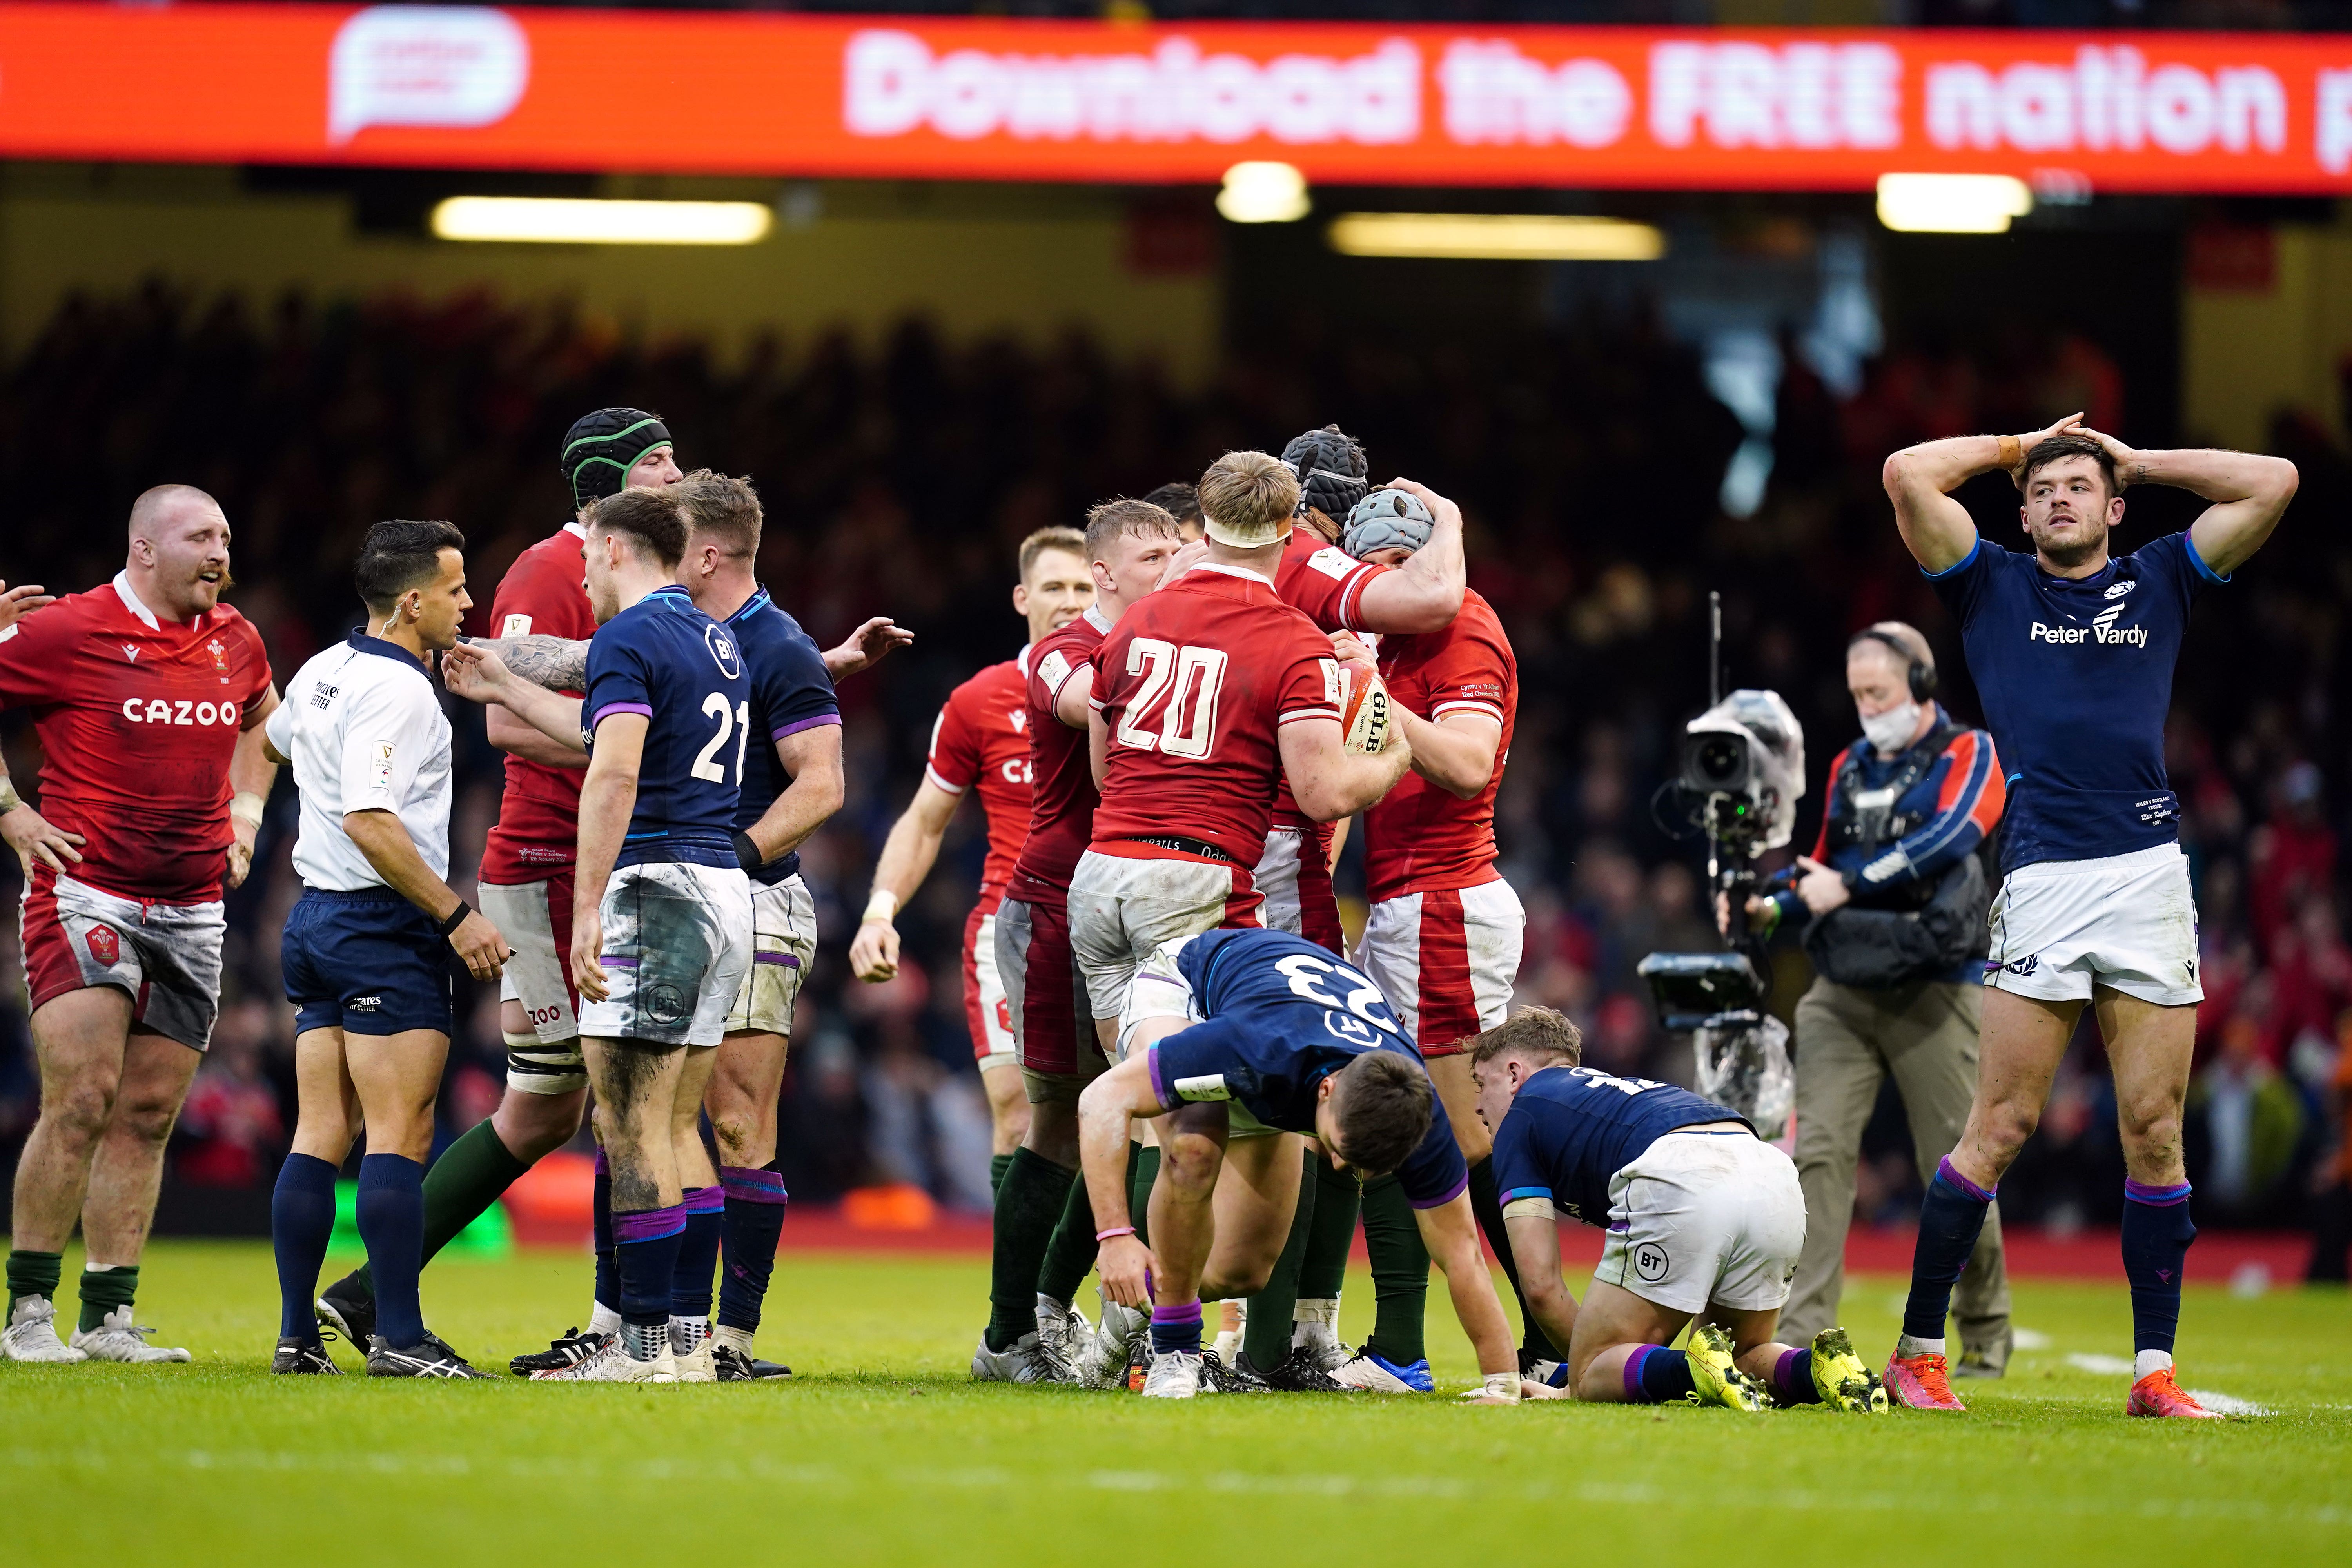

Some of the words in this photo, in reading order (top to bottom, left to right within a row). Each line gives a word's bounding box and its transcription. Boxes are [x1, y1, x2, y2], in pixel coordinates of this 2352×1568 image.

[843, 29, 1420, 142] Download
[1439, 38, 1632, 146] the
[1649, 41, 1902, 148] FREE
[1924, 44, 2286, 154] nation
[715, 639, 734, 661] BT
[2030, 621, 2089, 644] Peter
[2092, 624, 2148, 648] Vardy
[123, 698, 236, 726] CAZOO
[1117, 641, 1228, 760] 20
[1366, 692, 1385, 751] GILB
[686, 692, 749, 787] 21
[1275, 955, 1398, 1033] 23
[1341, 1016, 1370, 1037] BT
[1641, 1252, 1661, 1270] BT
